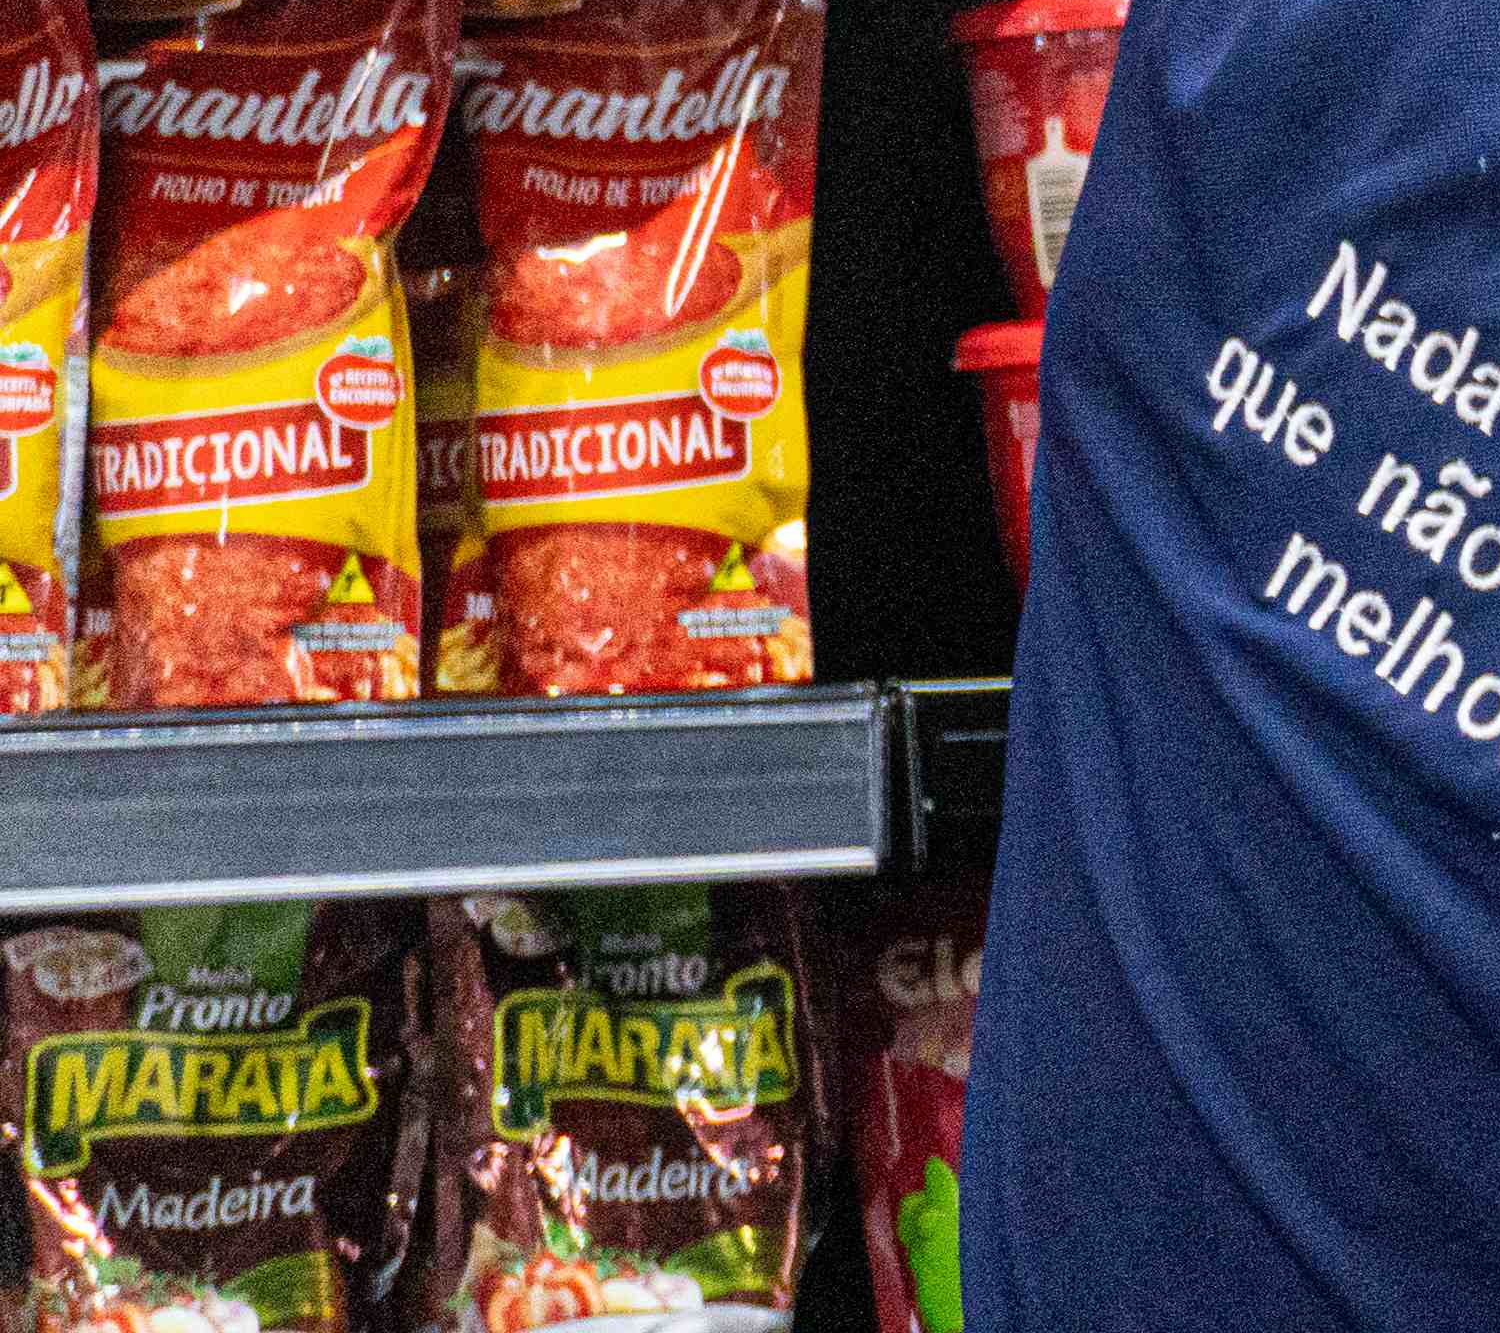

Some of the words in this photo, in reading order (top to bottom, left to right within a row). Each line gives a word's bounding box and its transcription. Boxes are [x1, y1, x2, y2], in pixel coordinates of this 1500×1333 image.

[150, 171, 228, 206] MOLHO
[230, 178, 261, 207] DE
[265, 166, 346, 209] TOMATE
[524, 166, 601, 206] MOLHO
[603, 178, 632, 209] DE
[1205, 337, 1335, 467] que
[93, 419, 353, 494] TRADICIONAL
[481, 411, 735, 481] TRADICIONAL
[138, 985, 297, 1031] Pronto
[49, 1039, 364, 1133] MARATA
[98, 1170, 317, 1230] Madeira
